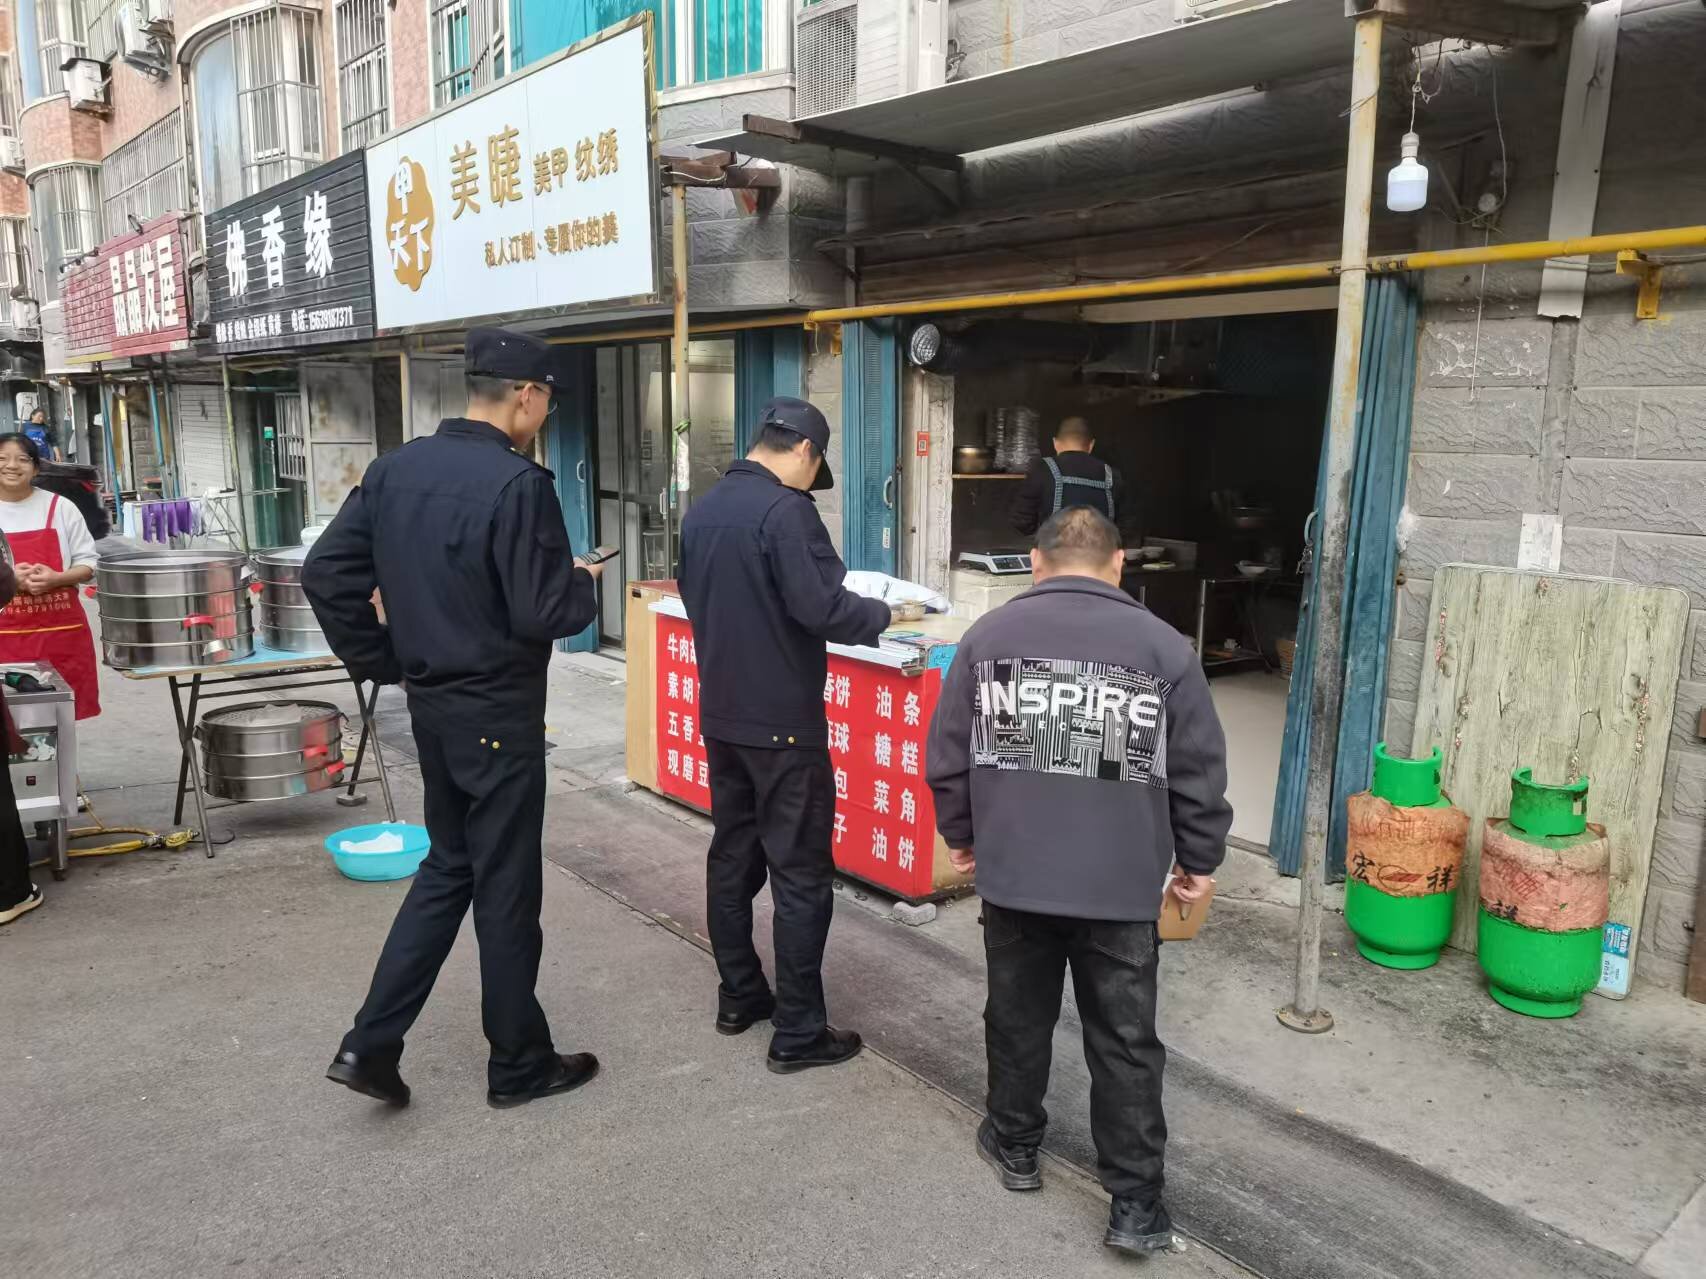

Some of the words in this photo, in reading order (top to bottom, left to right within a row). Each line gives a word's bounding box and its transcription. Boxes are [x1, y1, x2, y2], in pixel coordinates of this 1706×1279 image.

[450, 124, 523, 220] 美睫
[533, 151, 568, 196] 美甲
[226, 191, 334, 297] 佛香缘
[109, 234, 179, 337] 晶晶发屋
[667, 671, 700, 704] 素胡
[875, 685, 920, 727] 油条
[980, 681, 1159, 728] INSPIRE
[874, 731, 919, 776] 糖糕
[873, 780, 916, 824] 菜角
[871, 828, 915, 872] 油饼
